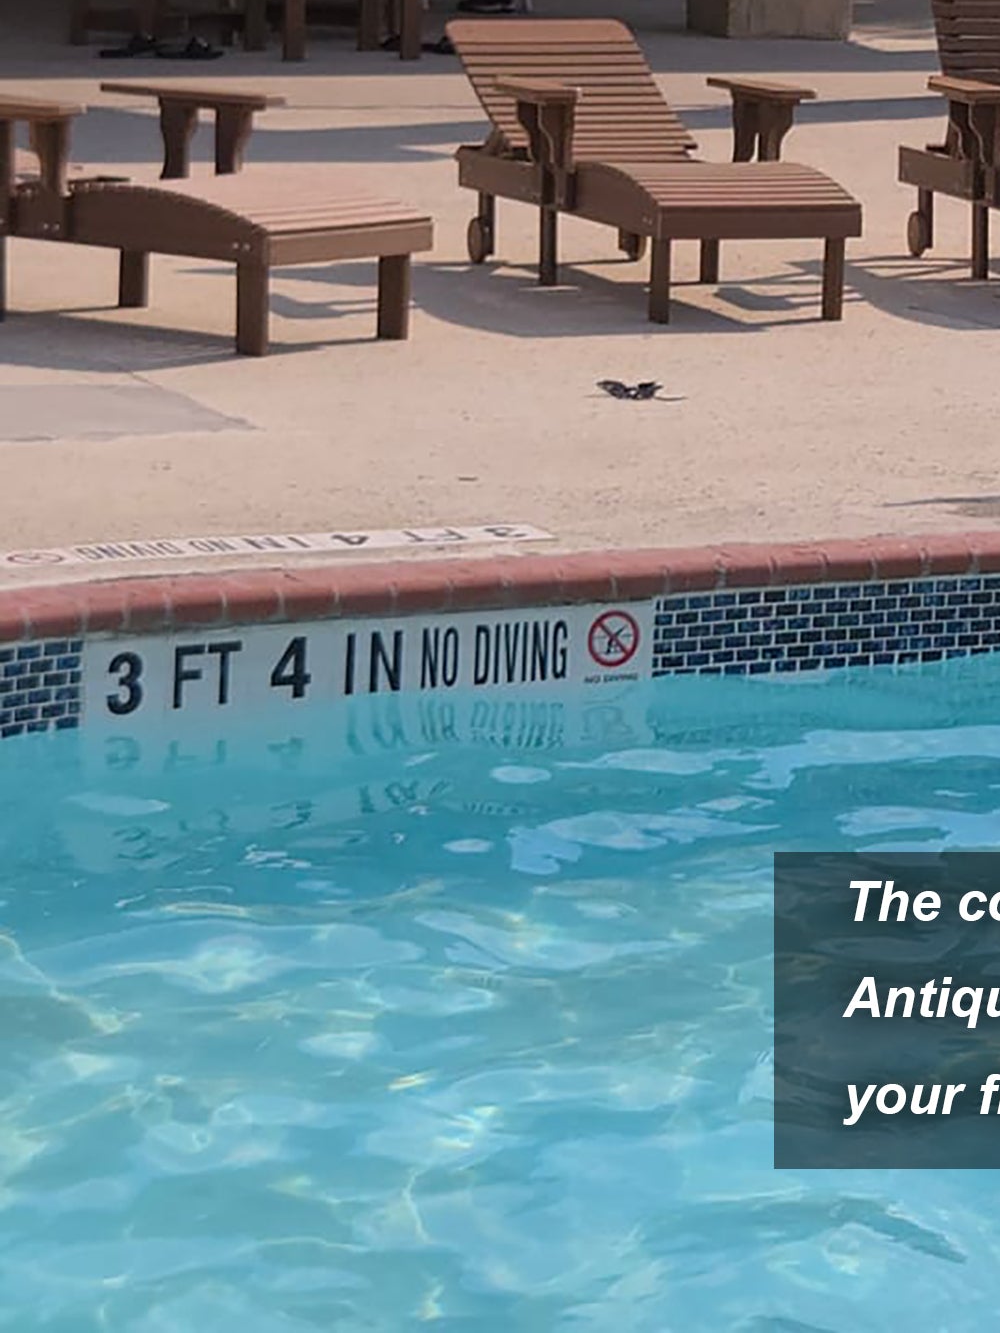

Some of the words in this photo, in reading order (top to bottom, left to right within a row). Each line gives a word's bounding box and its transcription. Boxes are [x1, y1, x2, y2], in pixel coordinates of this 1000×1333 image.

[331, 534, 369, 546] 4
[402, 529, 468, 542] FT
[188, 540, 237, 554] NO
[242, 536, 310, 551] IN
[76, 541, 184, 561] DIVING
[105, 651, 143, 716] 3
[172, 640, 243, 710] FT
[270, 636, 312, 699] 4
[344, 629, 404, 696] IN
[420, 627, 460, 690] NO
[473, 620, 569, 686] DIVING
